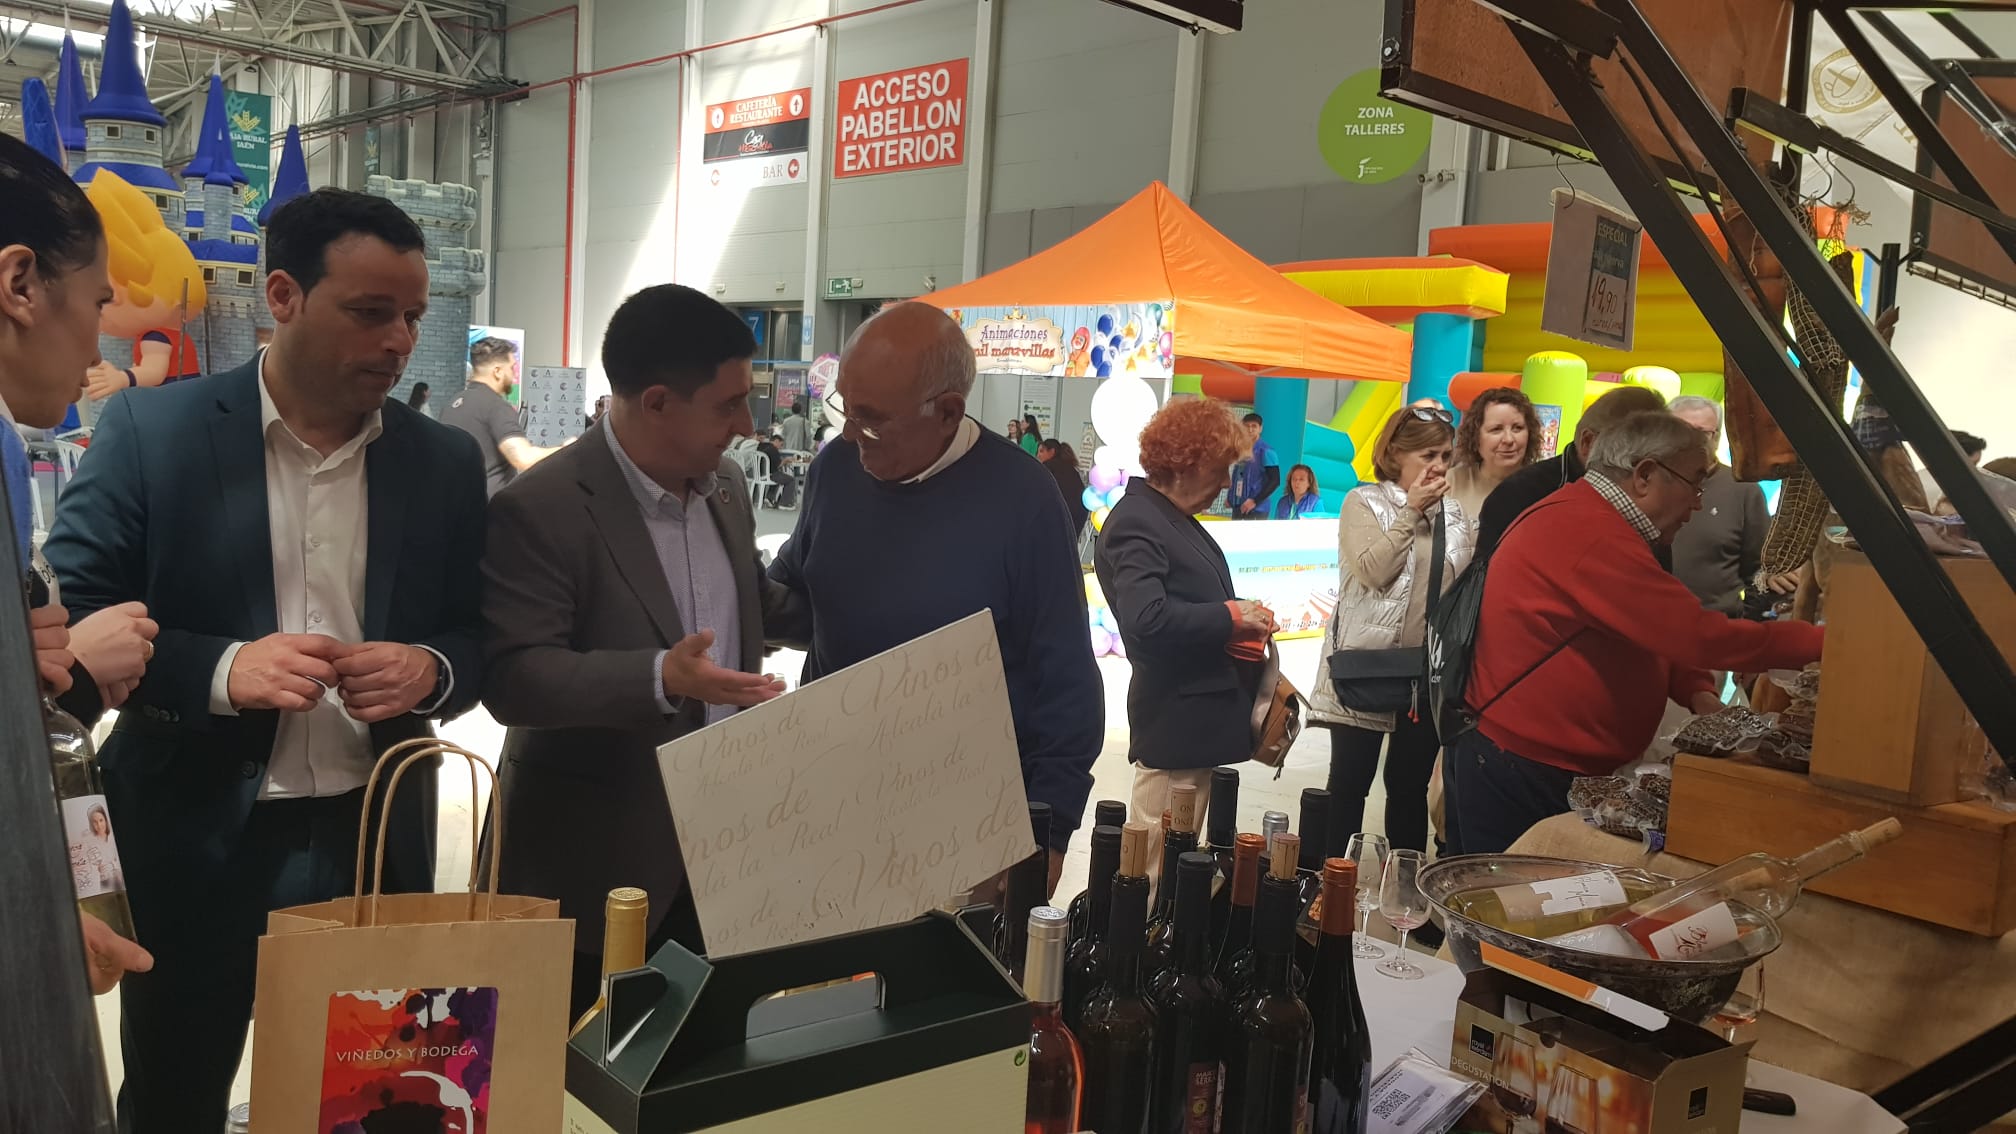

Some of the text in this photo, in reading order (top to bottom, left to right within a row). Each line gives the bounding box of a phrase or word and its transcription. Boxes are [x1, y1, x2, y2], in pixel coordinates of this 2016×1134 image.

[853, 68, 950, 110] ACCESO
[729, 106, 783, 123] RESTAURANTE
[841, 98, 961, 142] PABELLON
[1358, 107, 1394, 119] ZONA
[1344, 123, 1405, 136] TALLERES
[843, 132, 956, 172] EXTERIOR
[762, 164, 783, 179] BAR
[1598, 223, 1628, 247] ESPECIAL
[981, 324, 1048, 341] Animaciones
[991, 343, 1055, 359] maravillas
[840, 650, 962, 717] Vinos
[674, 722, 768, 774] Vinos
[856, 730, 968, 806] Vinos de
[812, 775, 1019, 913] Vinos de
[336, 1045, 479, 1062] VIÑEDOS Y BODEGA
[1451, 1056, 1509, 1089] DEGUSTATION
